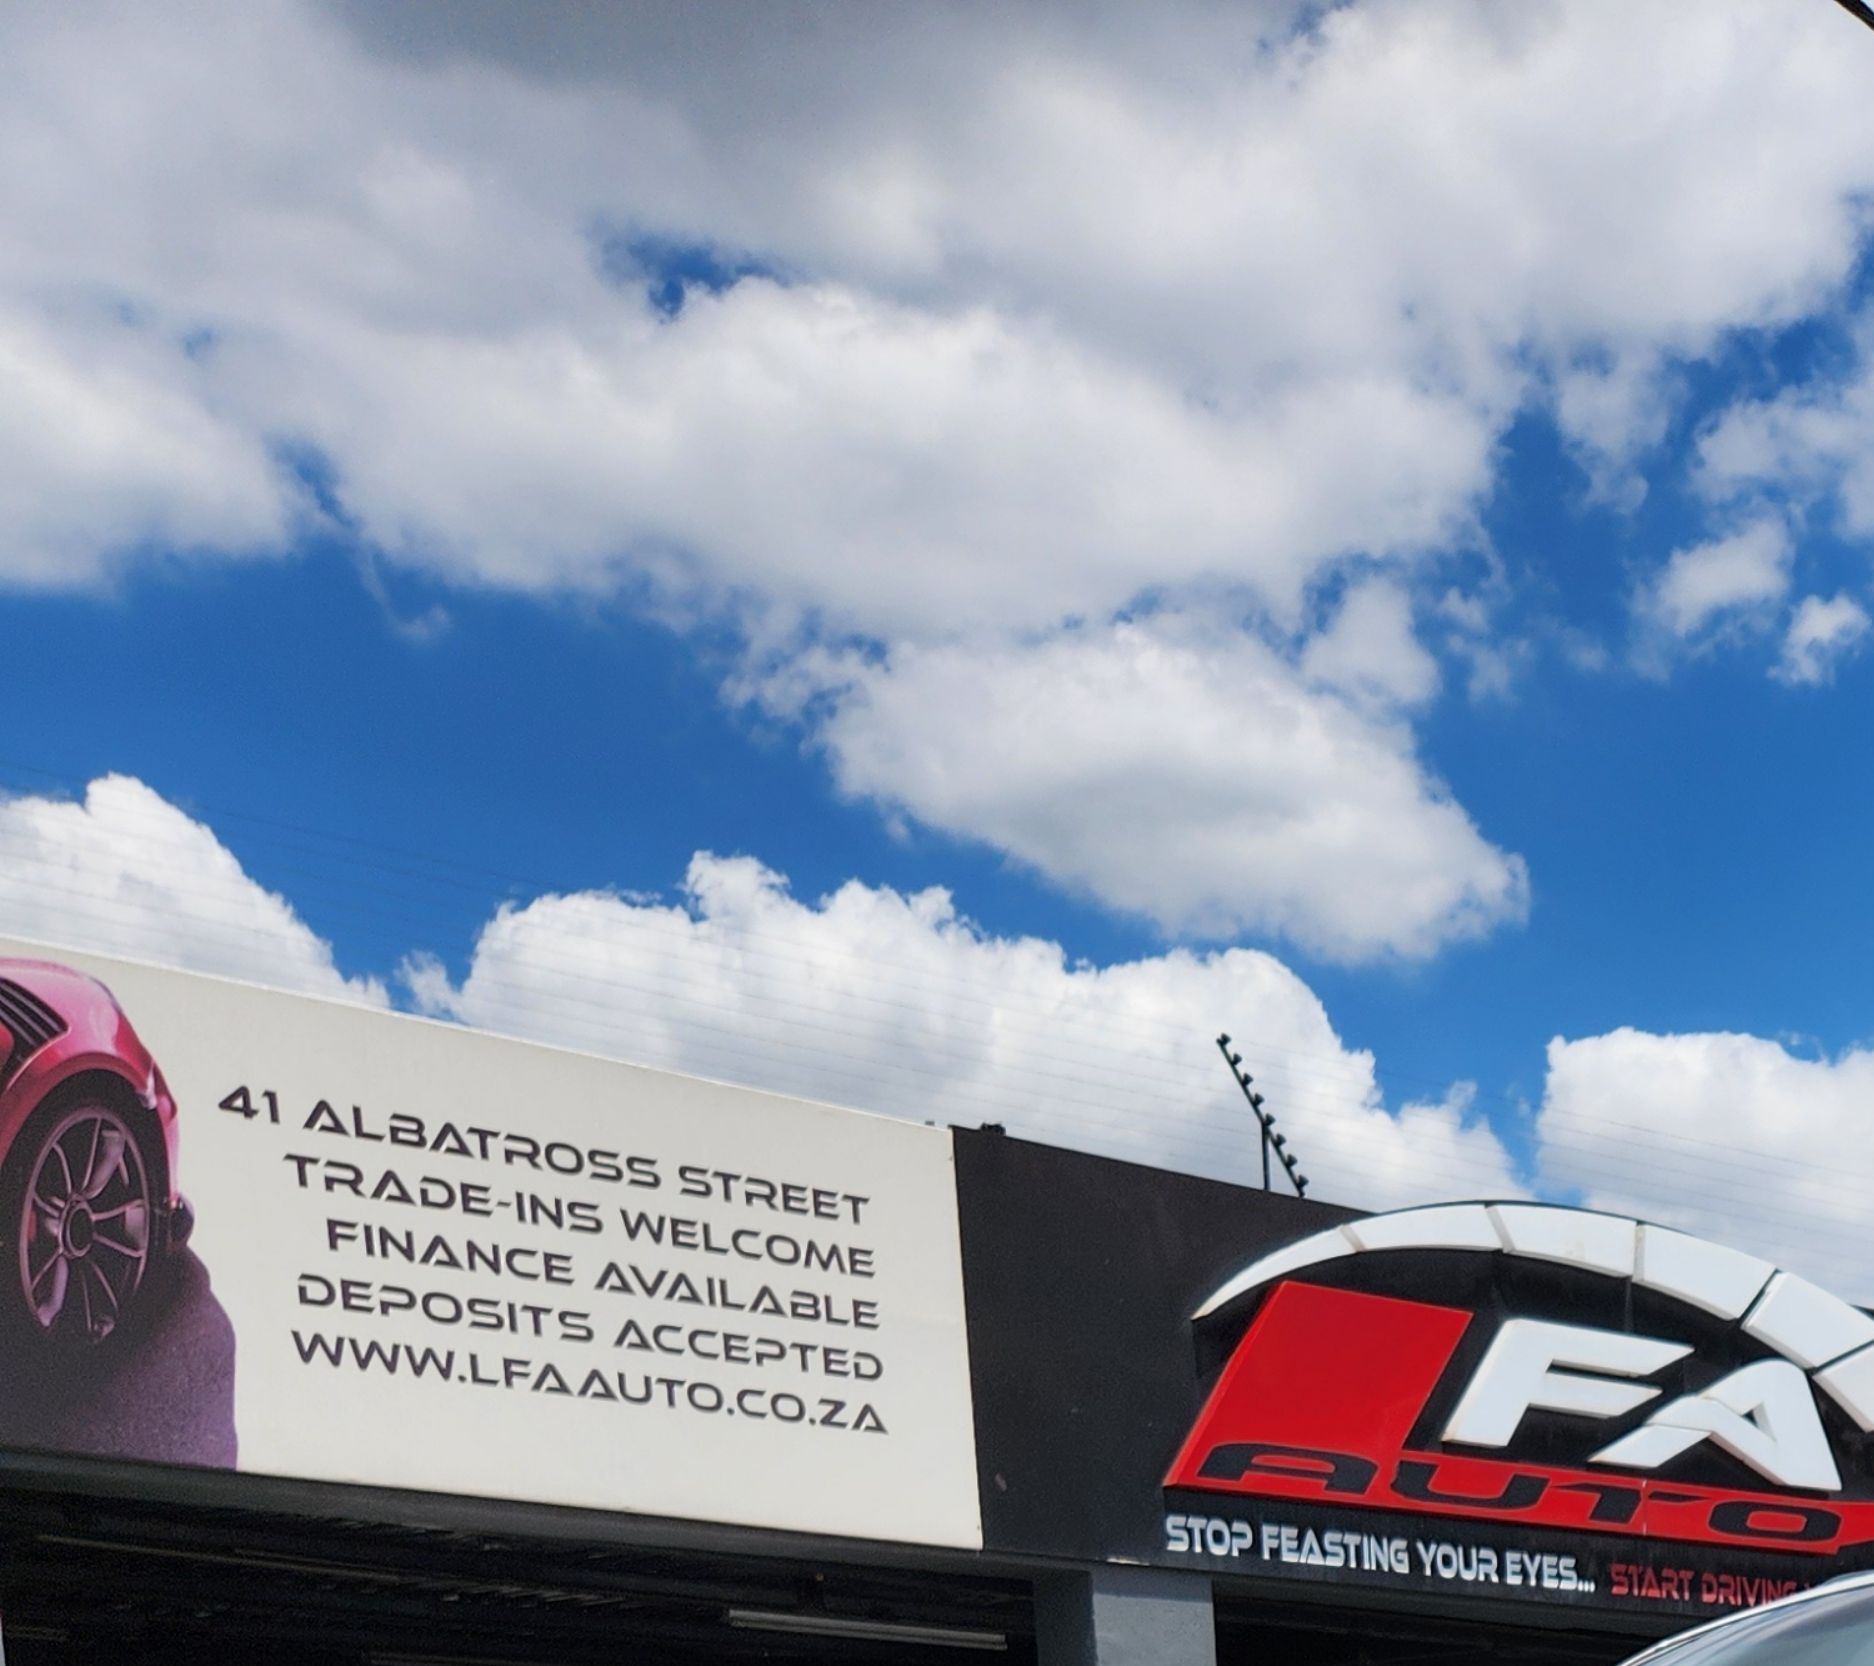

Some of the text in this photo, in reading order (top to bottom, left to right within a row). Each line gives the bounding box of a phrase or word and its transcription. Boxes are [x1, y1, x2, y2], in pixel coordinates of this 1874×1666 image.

[218, 1085, 870, 1225] 41 ALBATROSS STREET
[283, 1153, 875, 1278] TRADE-INS WELCOME
[298, 1273, 883, 1381] DEPOSITS ACCEPTED
[326, 1218, 880, 1329] FINANCE AVAILABLE
[291, 1330, 889, 1434] WWW.LFAAUTO.CO.ZA
[1195, 1443, 1842, 1542] AUTO
[1166, 1515, 1253, 1557] STOP
[1261, 1523, 1410, 1574] FEASTING
[1417, 1540, 1499, 1583] YOUR
[1506, 1550, 1596, 1592] EYES...
[1610, 1563, 1695, 1600] START
